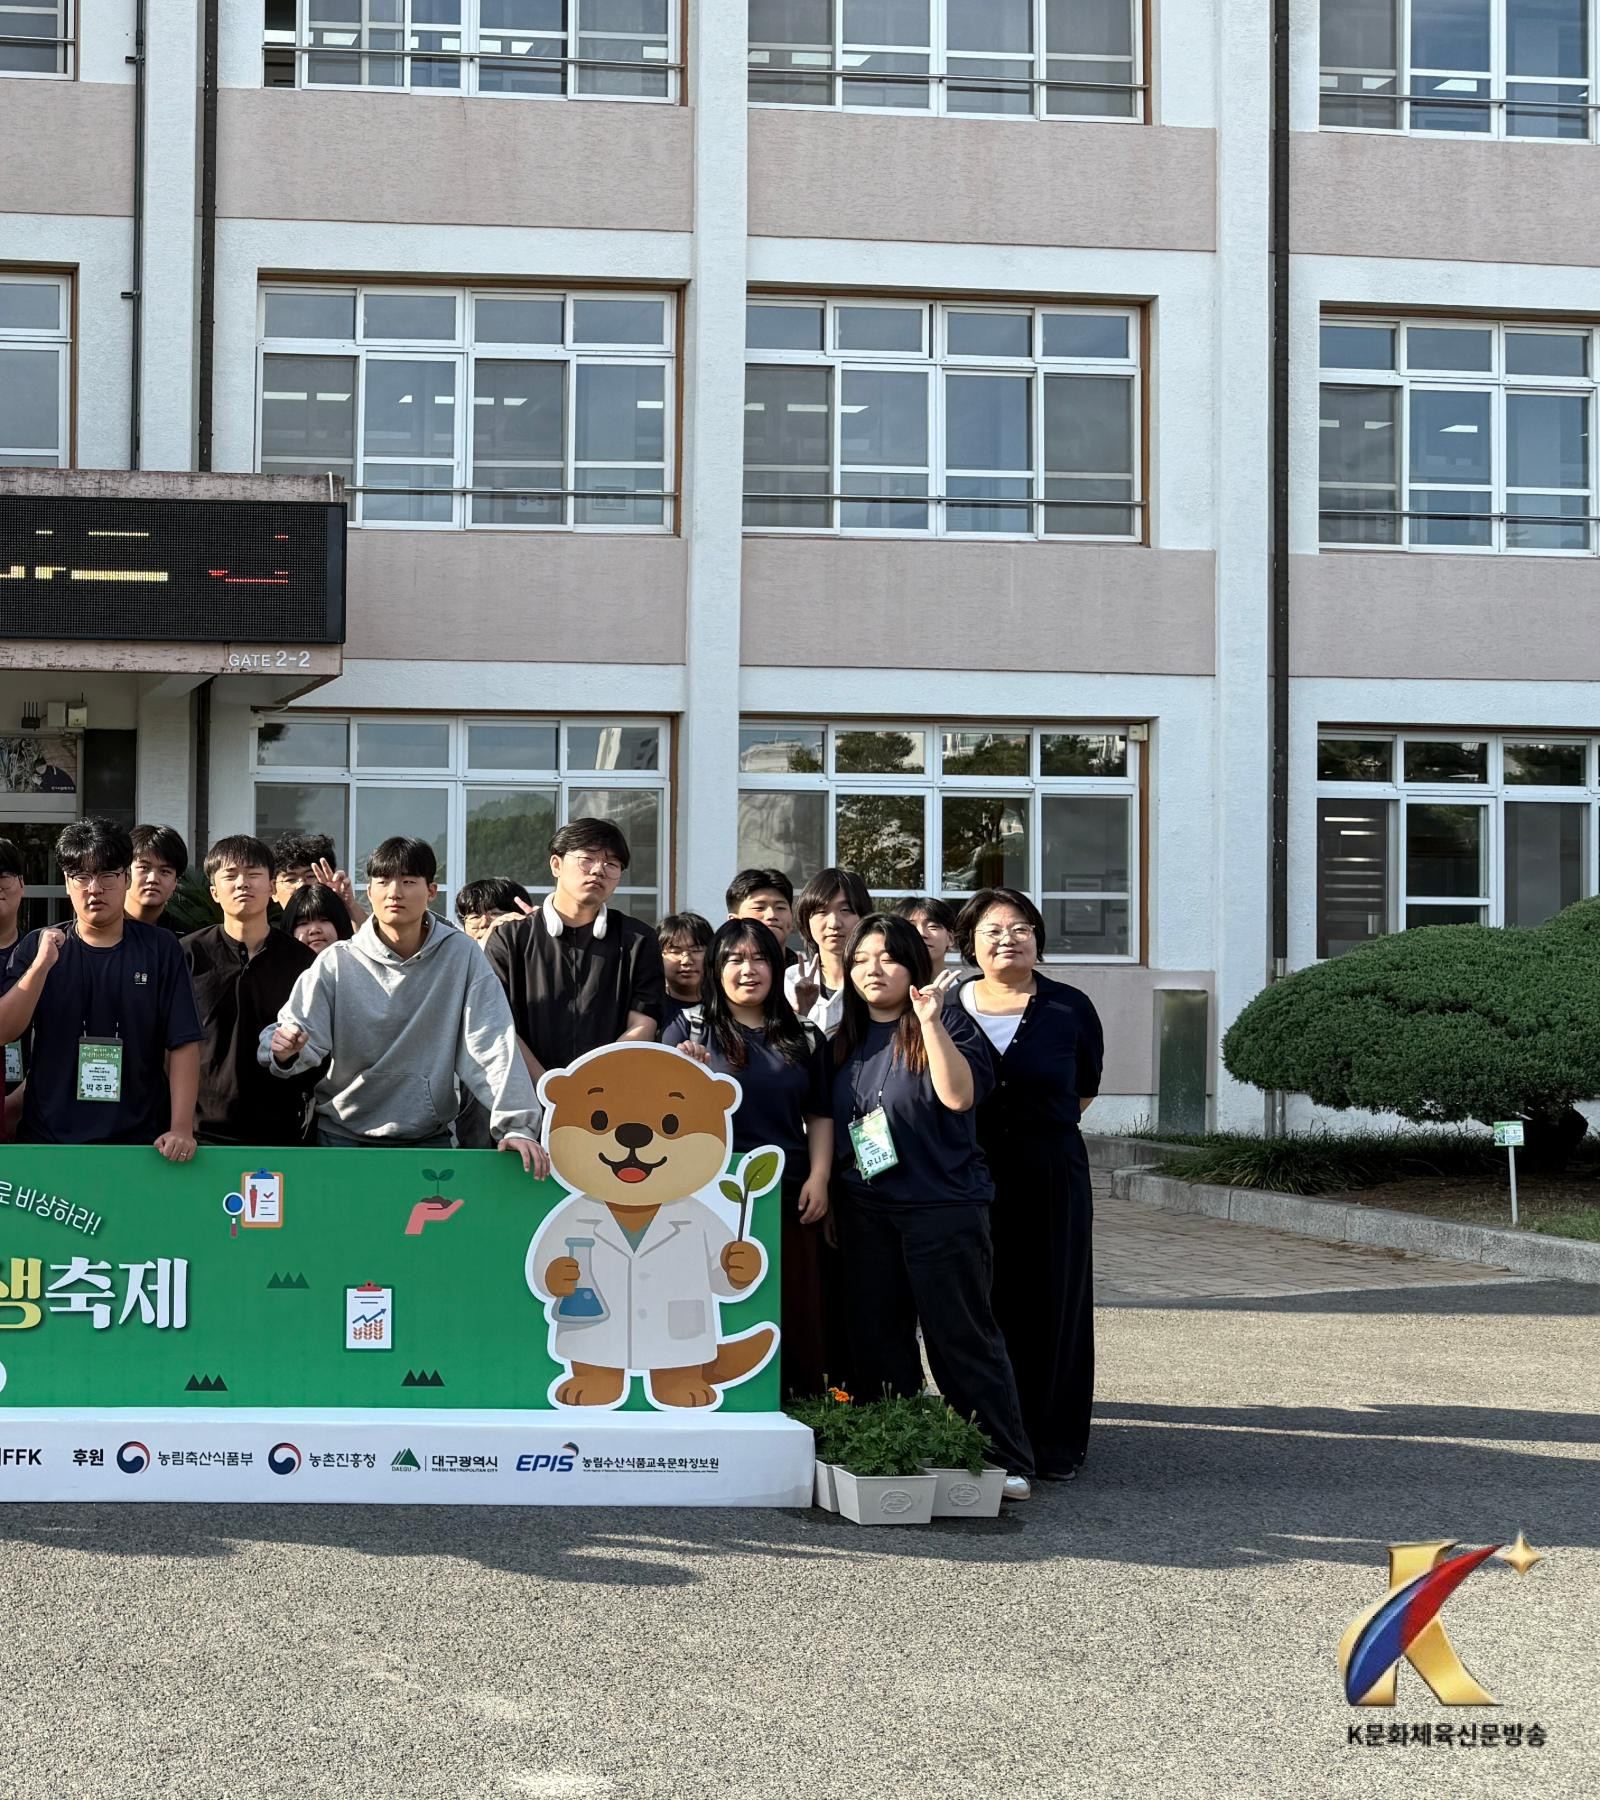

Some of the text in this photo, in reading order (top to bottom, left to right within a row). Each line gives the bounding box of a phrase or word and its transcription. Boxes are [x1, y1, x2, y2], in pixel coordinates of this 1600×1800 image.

[229, 650, 311, 668] GATE 2-2
[15, 1180, 102, 1237] 비상하라!
[72, 1448, 104, 1467] 후원
[158, 1450, 254, 1466] 농림축산식품부
[309, 1452, 376, 1468] 농촌진흥청
[432, 1455, 498, 1468] 대구광역시
[516, 1454, 574, 1472] EPIS
[582, 1456, 719, 1470] 농림수산식품교육문화정보원
